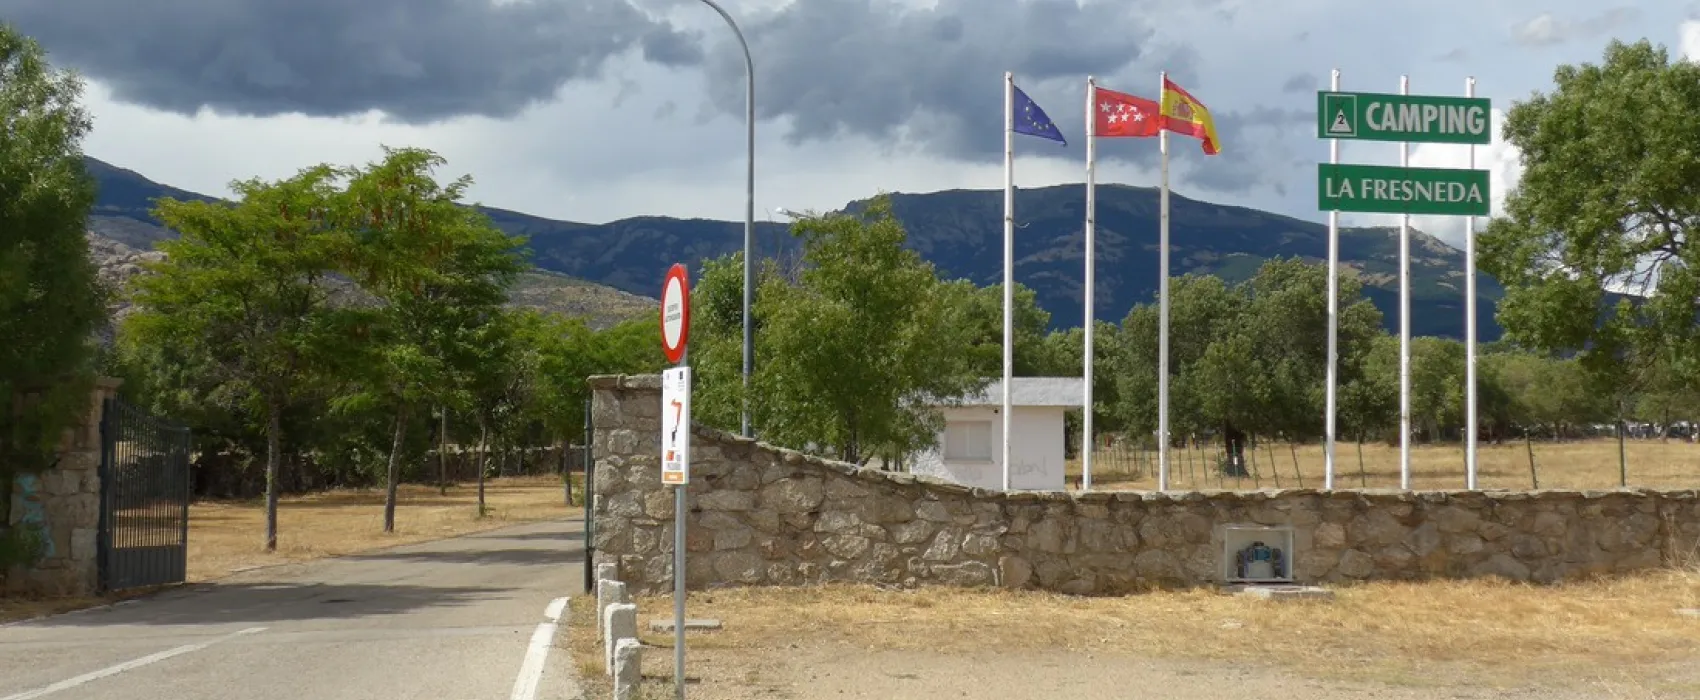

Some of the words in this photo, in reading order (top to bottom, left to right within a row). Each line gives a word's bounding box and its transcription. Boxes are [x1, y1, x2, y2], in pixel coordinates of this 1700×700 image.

[1337, 114, 1345, 125] 2
[1366, 101, 1485, 135] CAMPING
[1325, 177, 1355, 199] LA
[1361, 179, 1483, 204] FRESNEDA
